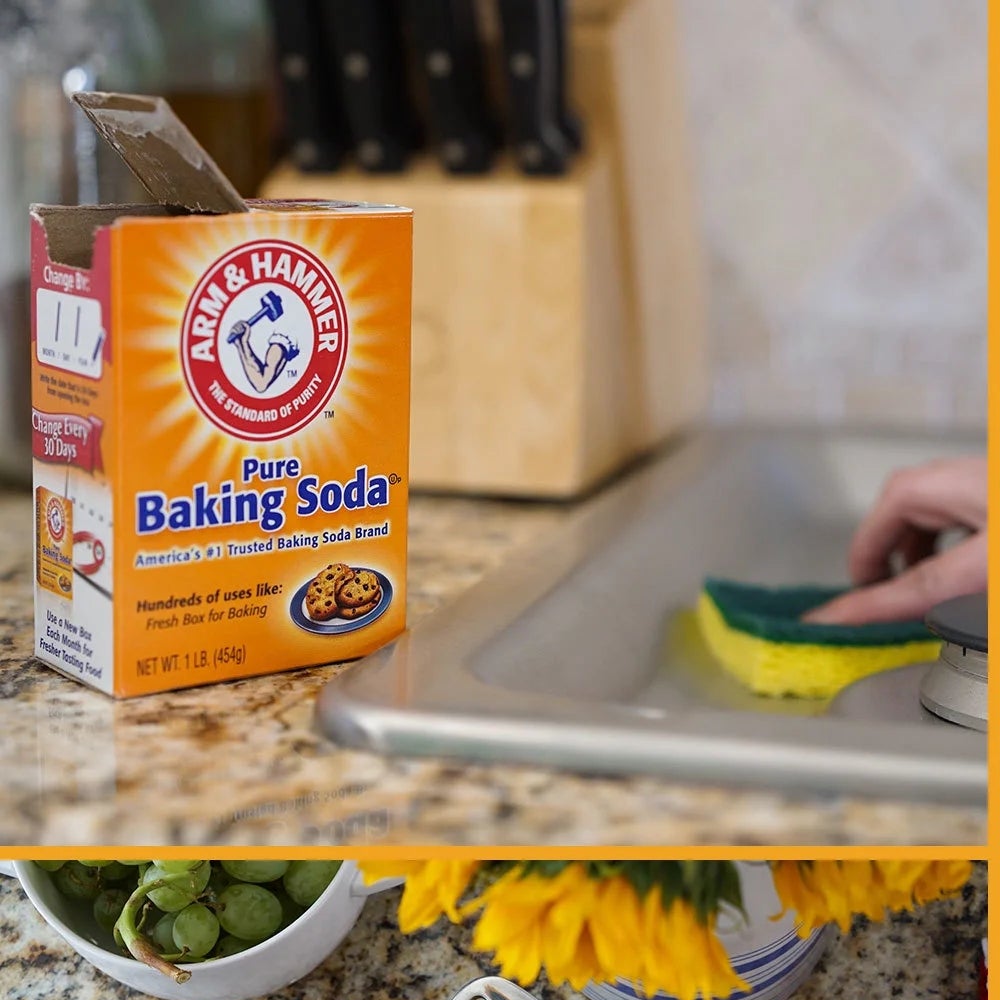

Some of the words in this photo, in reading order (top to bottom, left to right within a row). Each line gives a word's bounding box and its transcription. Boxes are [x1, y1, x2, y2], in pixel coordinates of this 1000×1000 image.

[43, 265, 74, 292] Change
[191, 282, 230, 363] ARM
[223, 263, 250, 293] &
[250, 251, 339, 353] HAMMER
[208, 379, 225, 405] THE
[223, 398, 279, 422] STANDARD
[280, 403, 293, 418] OF
[292, 373, 323, 411] PURITY
[32, 412, 62, 440] Change
[64, 417, 88, 446] Every
[44, 438, 54, 456] 30
[56, 438, 77, 462] Days
[243, 458, 299, 481] Pure
[138, 484, 285, 531] Baking
[297, 468, 389, 515] Soda
[135, 548, 200, 567] America's
[206, 544, 222, 559] #1
[227, 538, 273, 556] Trusted
[277, 532, 319, 549] Baking
[322, 528, 351, 544] Soda
[355, 523, 389, 539] Brand
[136, 592, 202, 613] Hundreds
[206, 588, 221, 604] of
[223, 588, 252, 601] uses
[256, 583, 283, 598] like:
[46, 609, 57, 625] Use
[58, 618, 63, 627] a
[64, 619, 78, 634] New
[79, 626, 92, 641] Box
[146, 613, 179, 631] Fresh
[182, 612, 206, 627] Box
[207, 608, 225, 622] for
[227, 603, 268, 620] Baking
[46, 625, 61, 642] Each
[61, 633, 82, 653] Month
[82, 643, 93, 658] for
[39, 637, 61, 658] Fresher
[62, 649, 84, 674] Tasting
[85, 662, 103, 680] Food
[136, 656, 159, 677] NET
[160, 653, 181, 673] WT.
[184, 652, 191, 669] 1
[193, 650, 211, 669] LB.
[213, 644, 247, 670] (454g)
